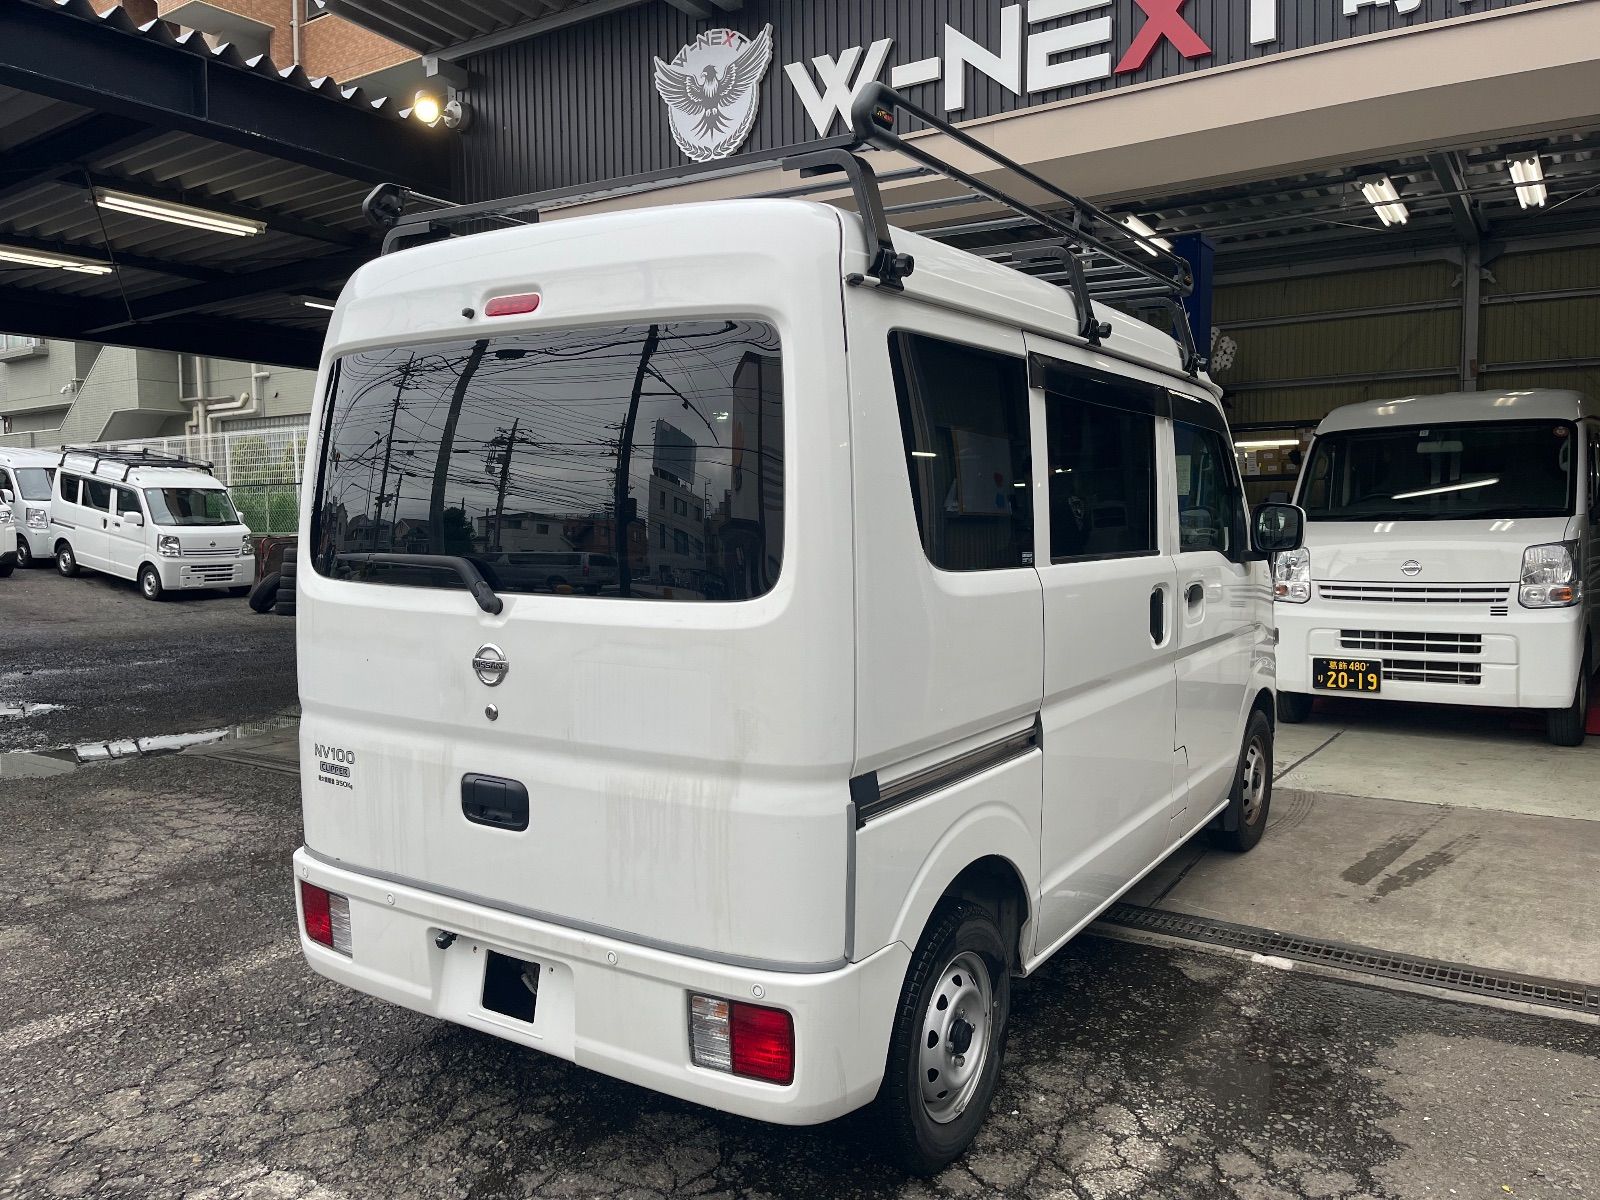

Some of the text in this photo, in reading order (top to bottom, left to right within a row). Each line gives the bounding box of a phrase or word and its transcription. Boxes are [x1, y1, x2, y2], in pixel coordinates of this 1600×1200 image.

[671, 30, 748, 67] W-NEXT
[473, 660, 504, 670] NISSAN
[1348, 661, 1367, 672] 480
[1326, 671, 1378, 690] 20-19
[314, 742, 356, 765] NV100
[321, 762, 349, 777] CLIPPER
